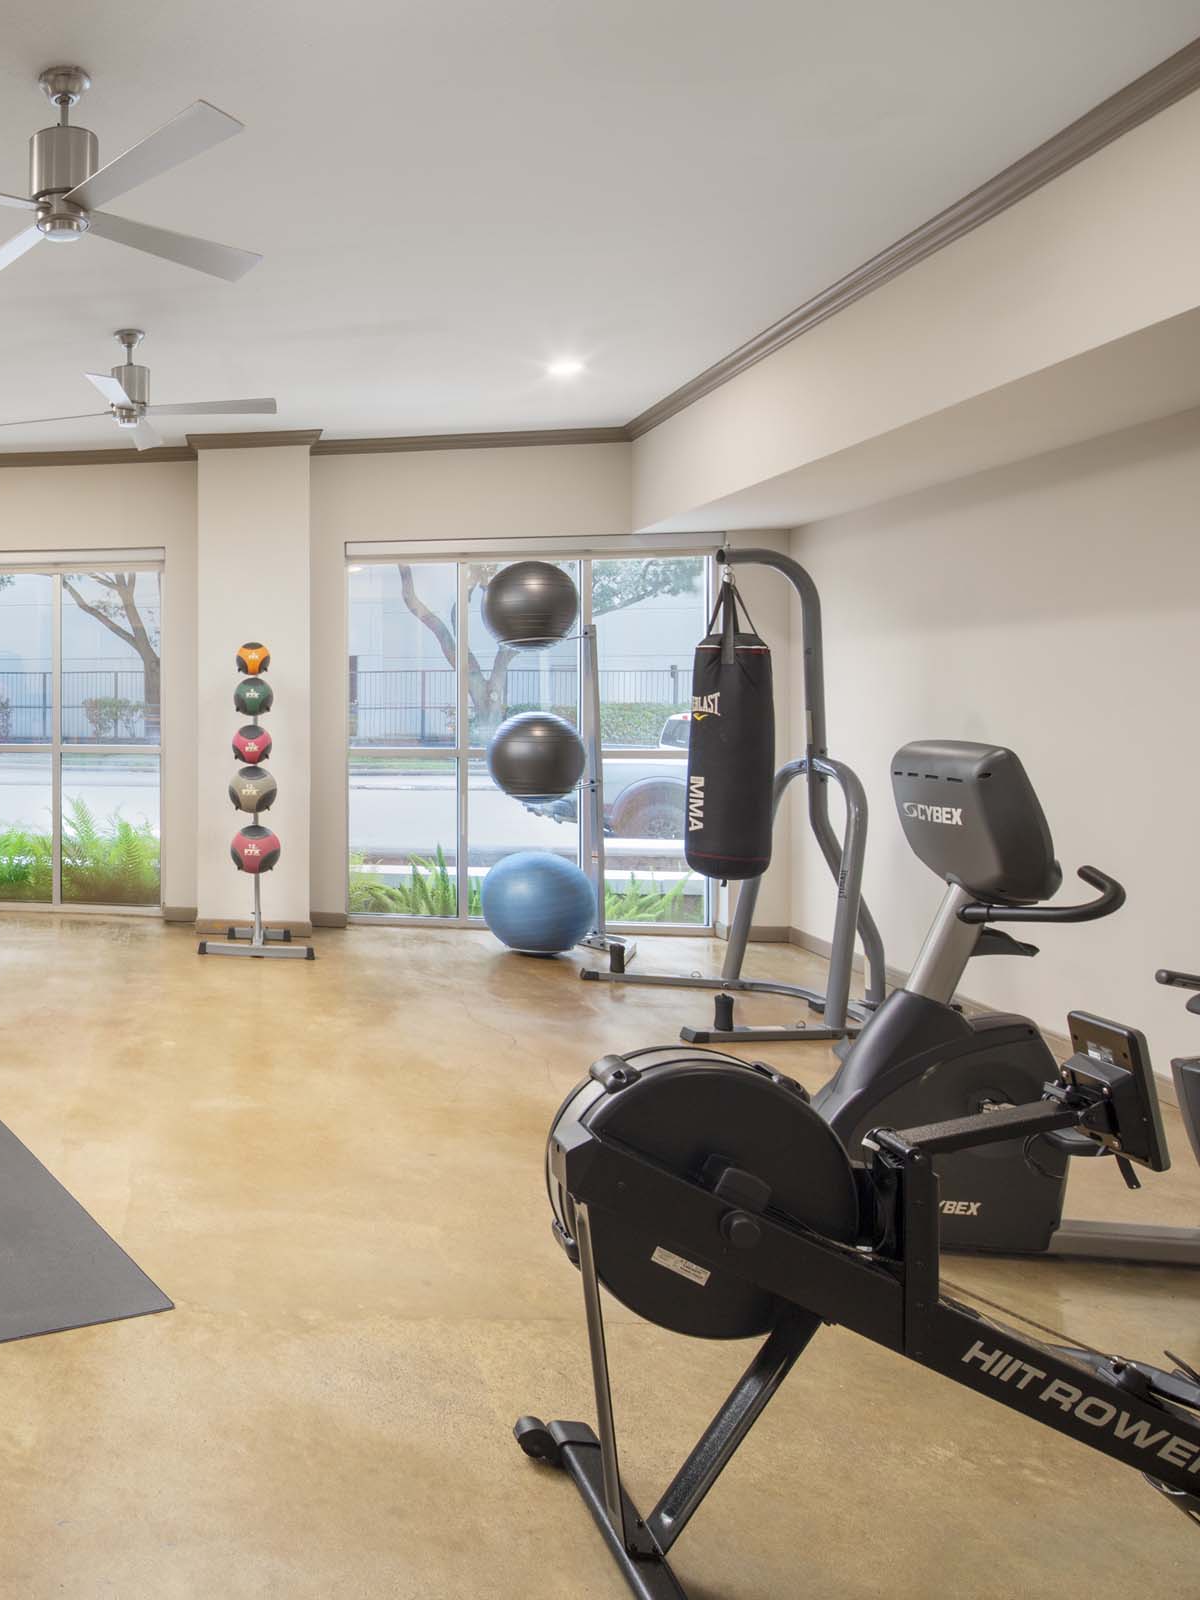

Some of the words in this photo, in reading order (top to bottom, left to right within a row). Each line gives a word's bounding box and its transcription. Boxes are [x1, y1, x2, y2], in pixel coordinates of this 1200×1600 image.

[689, 776, 705, 831] MMA
[917, 803, 963, 825] CYBEX
[961, 1340, 1047, 1390] HIIT
[1039, 1378, 1200, 1474] ROWE
